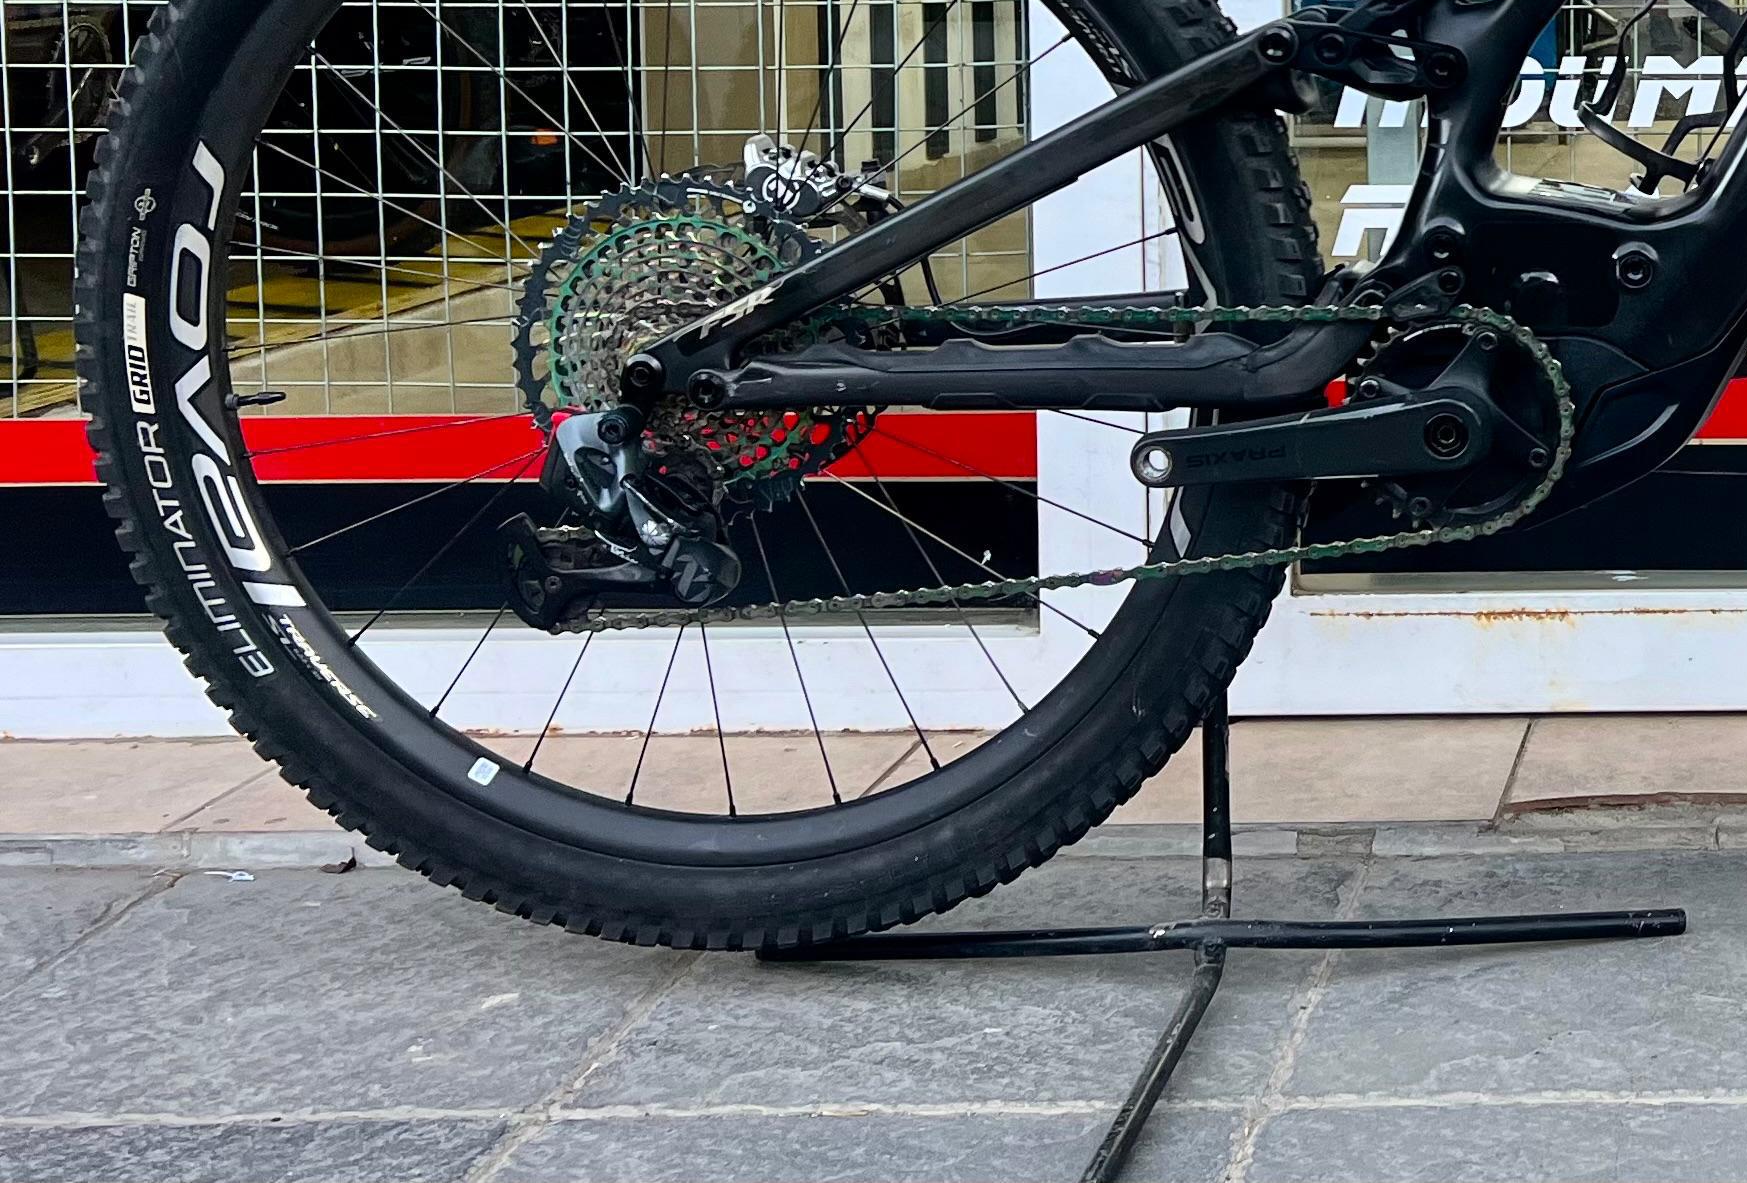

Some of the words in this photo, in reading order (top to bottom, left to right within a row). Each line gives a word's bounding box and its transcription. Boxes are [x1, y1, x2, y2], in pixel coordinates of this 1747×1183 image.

[127, 226, 141, 288] GRIPTON
[128, 344, 151, 406] GRID
[170, 140, 307, 608] ROVAL
[1186, 444, 1286, 469] PRAXIS
[137, 420, 276, 678] ELIMINATOR
[280, 614, 378, 719] TRAVERSE
